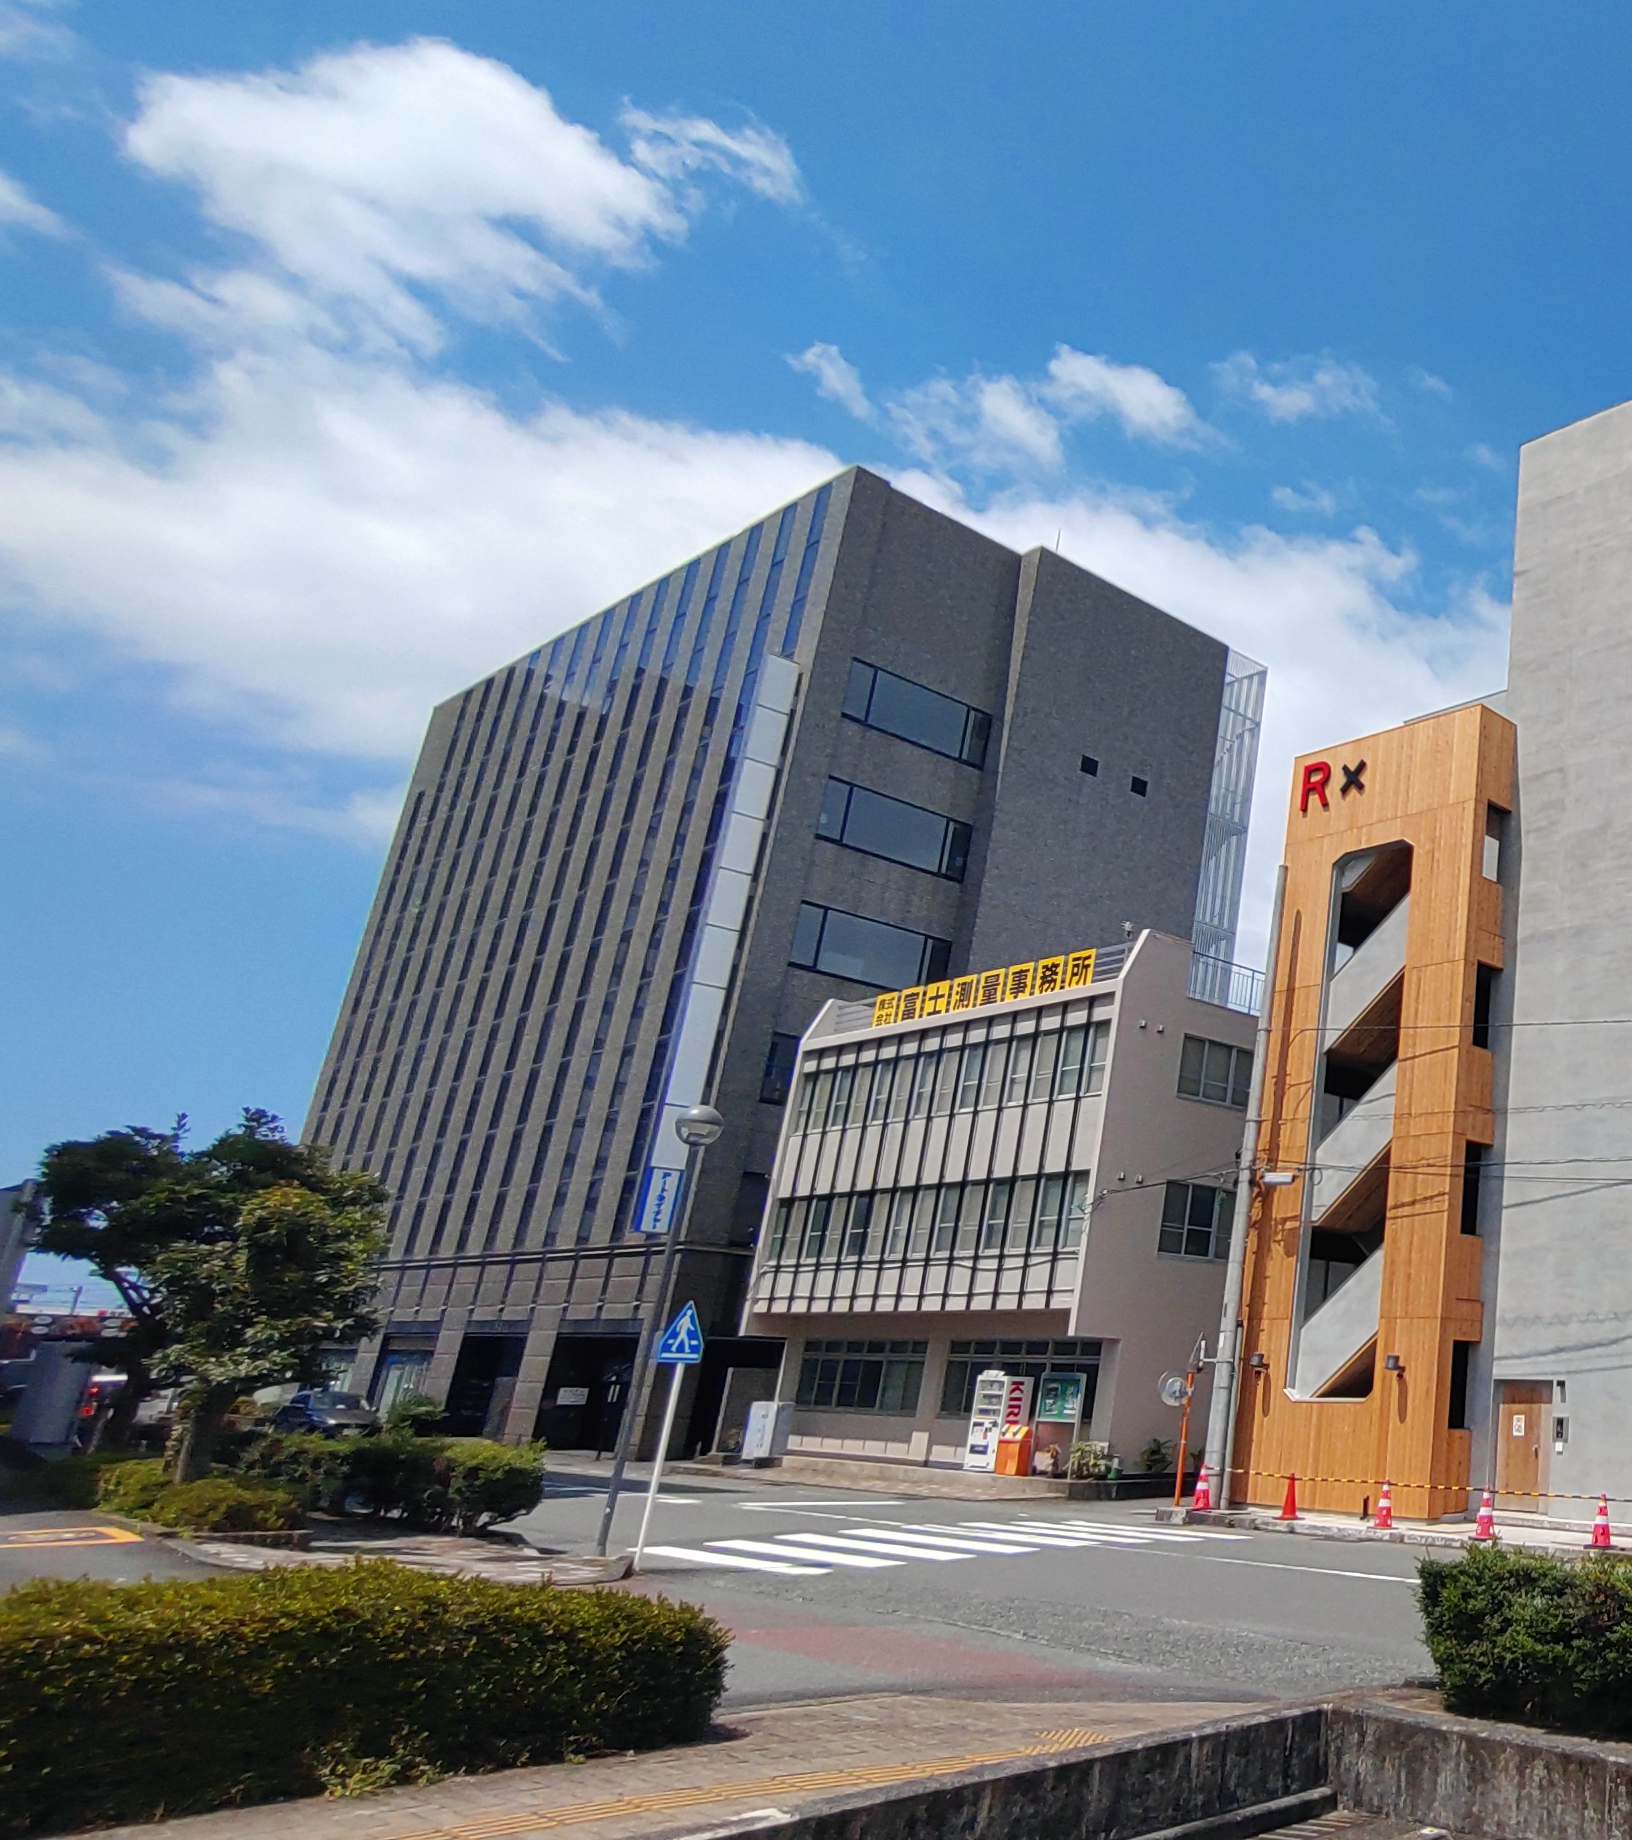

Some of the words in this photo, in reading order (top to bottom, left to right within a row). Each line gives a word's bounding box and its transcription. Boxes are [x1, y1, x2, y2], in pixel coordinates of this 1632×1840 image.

[900, 954, 1093, 1022] 富士測量事務所
[1004, 1381, 1025, 1425] KIRI
